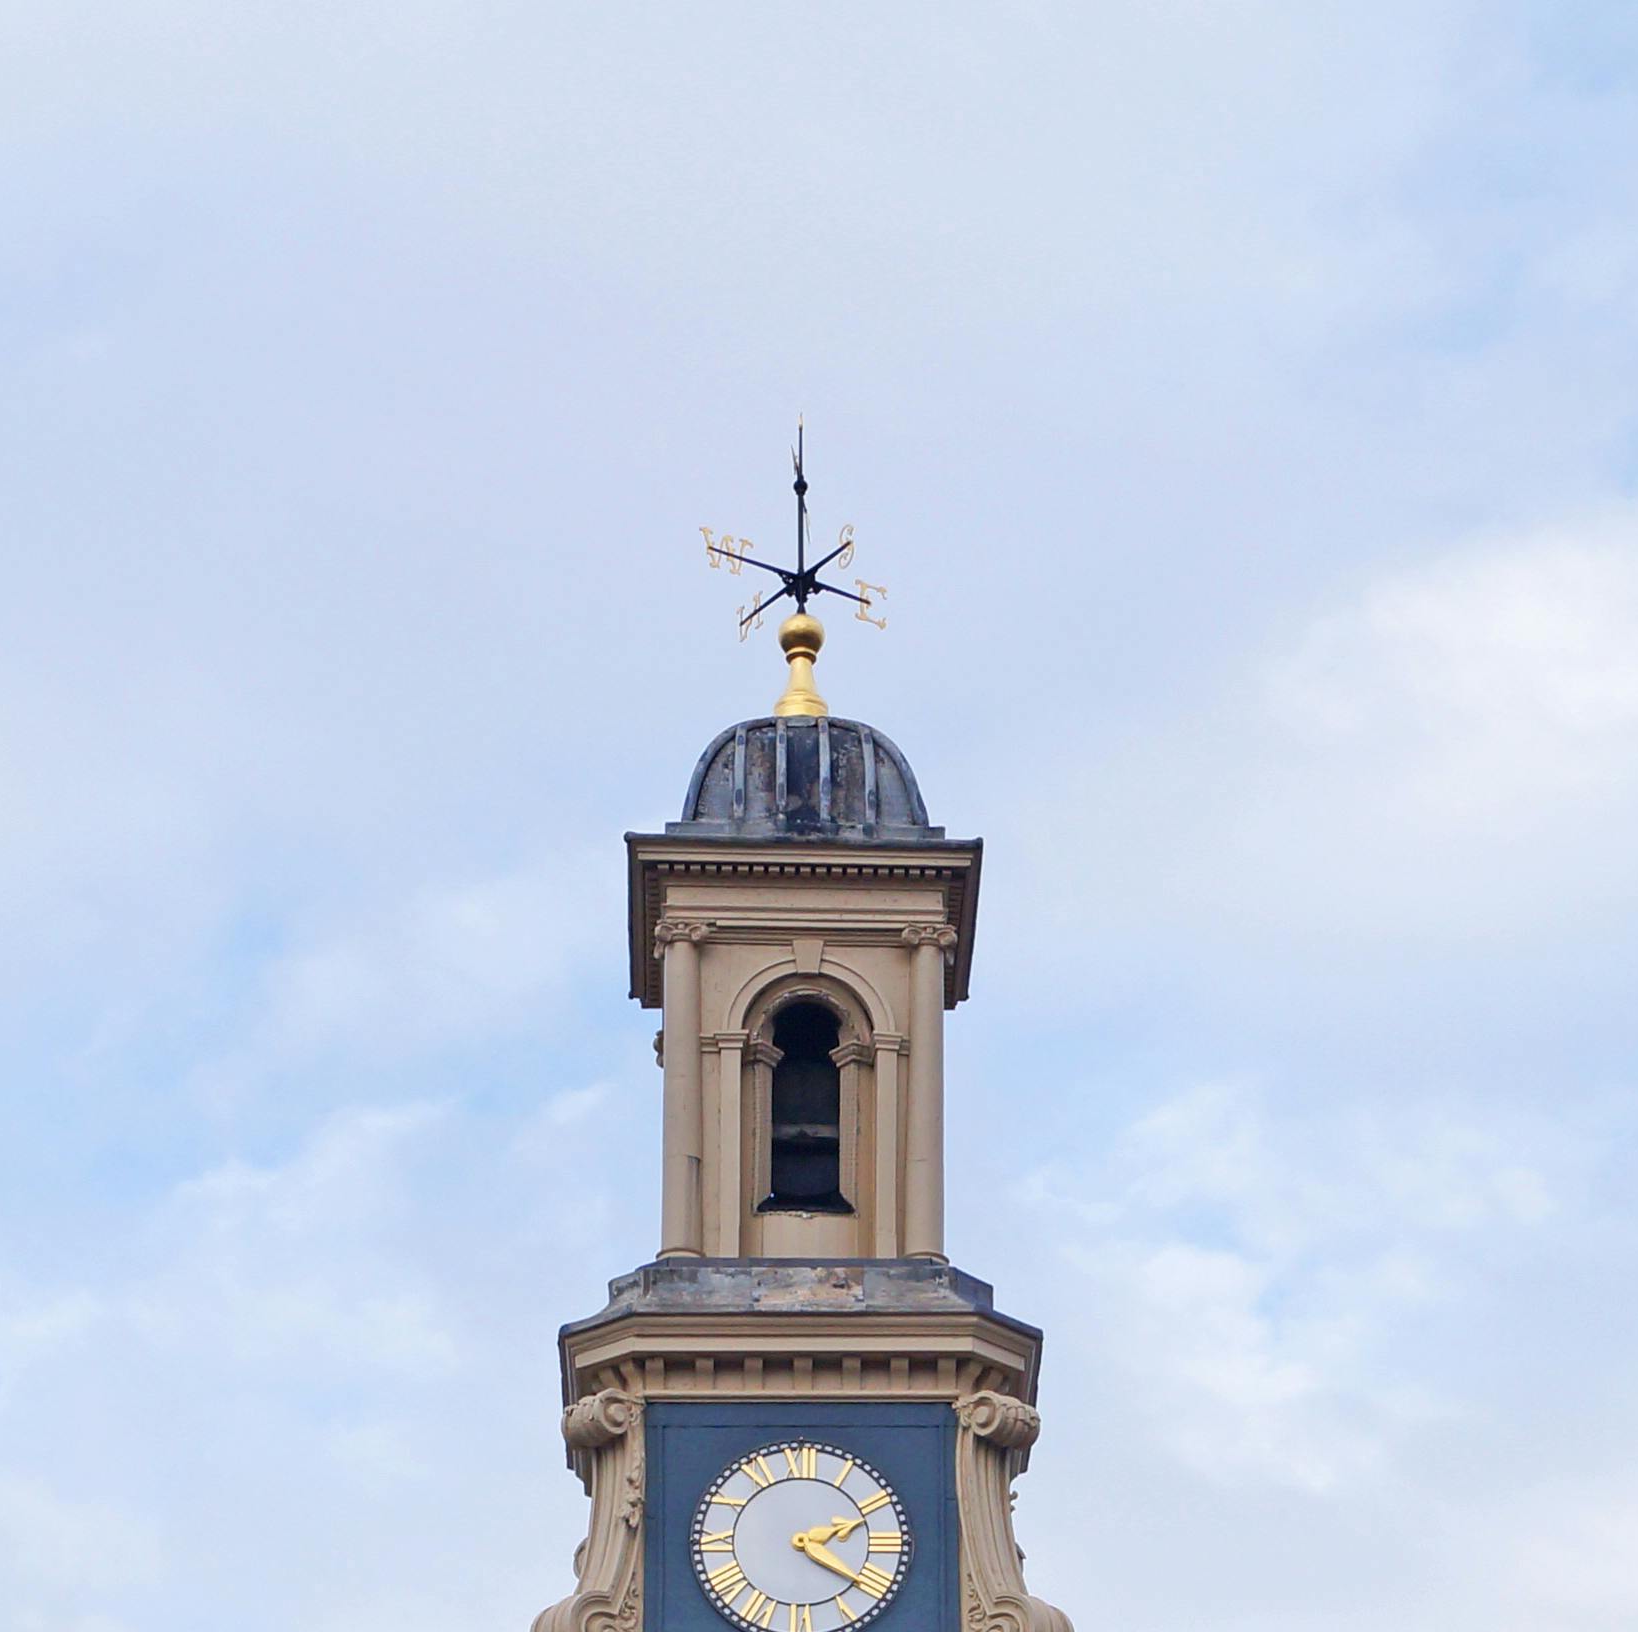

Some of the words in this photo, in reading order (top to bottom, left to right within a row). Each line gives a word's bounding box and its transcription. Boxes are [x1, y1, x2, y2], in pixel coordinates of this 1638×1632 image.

[698, 526, 754, 576] W
[838, 523, 855, 570] S
[855, 578, 888, 630] E
[784, 1447, 818, 1479] XII
